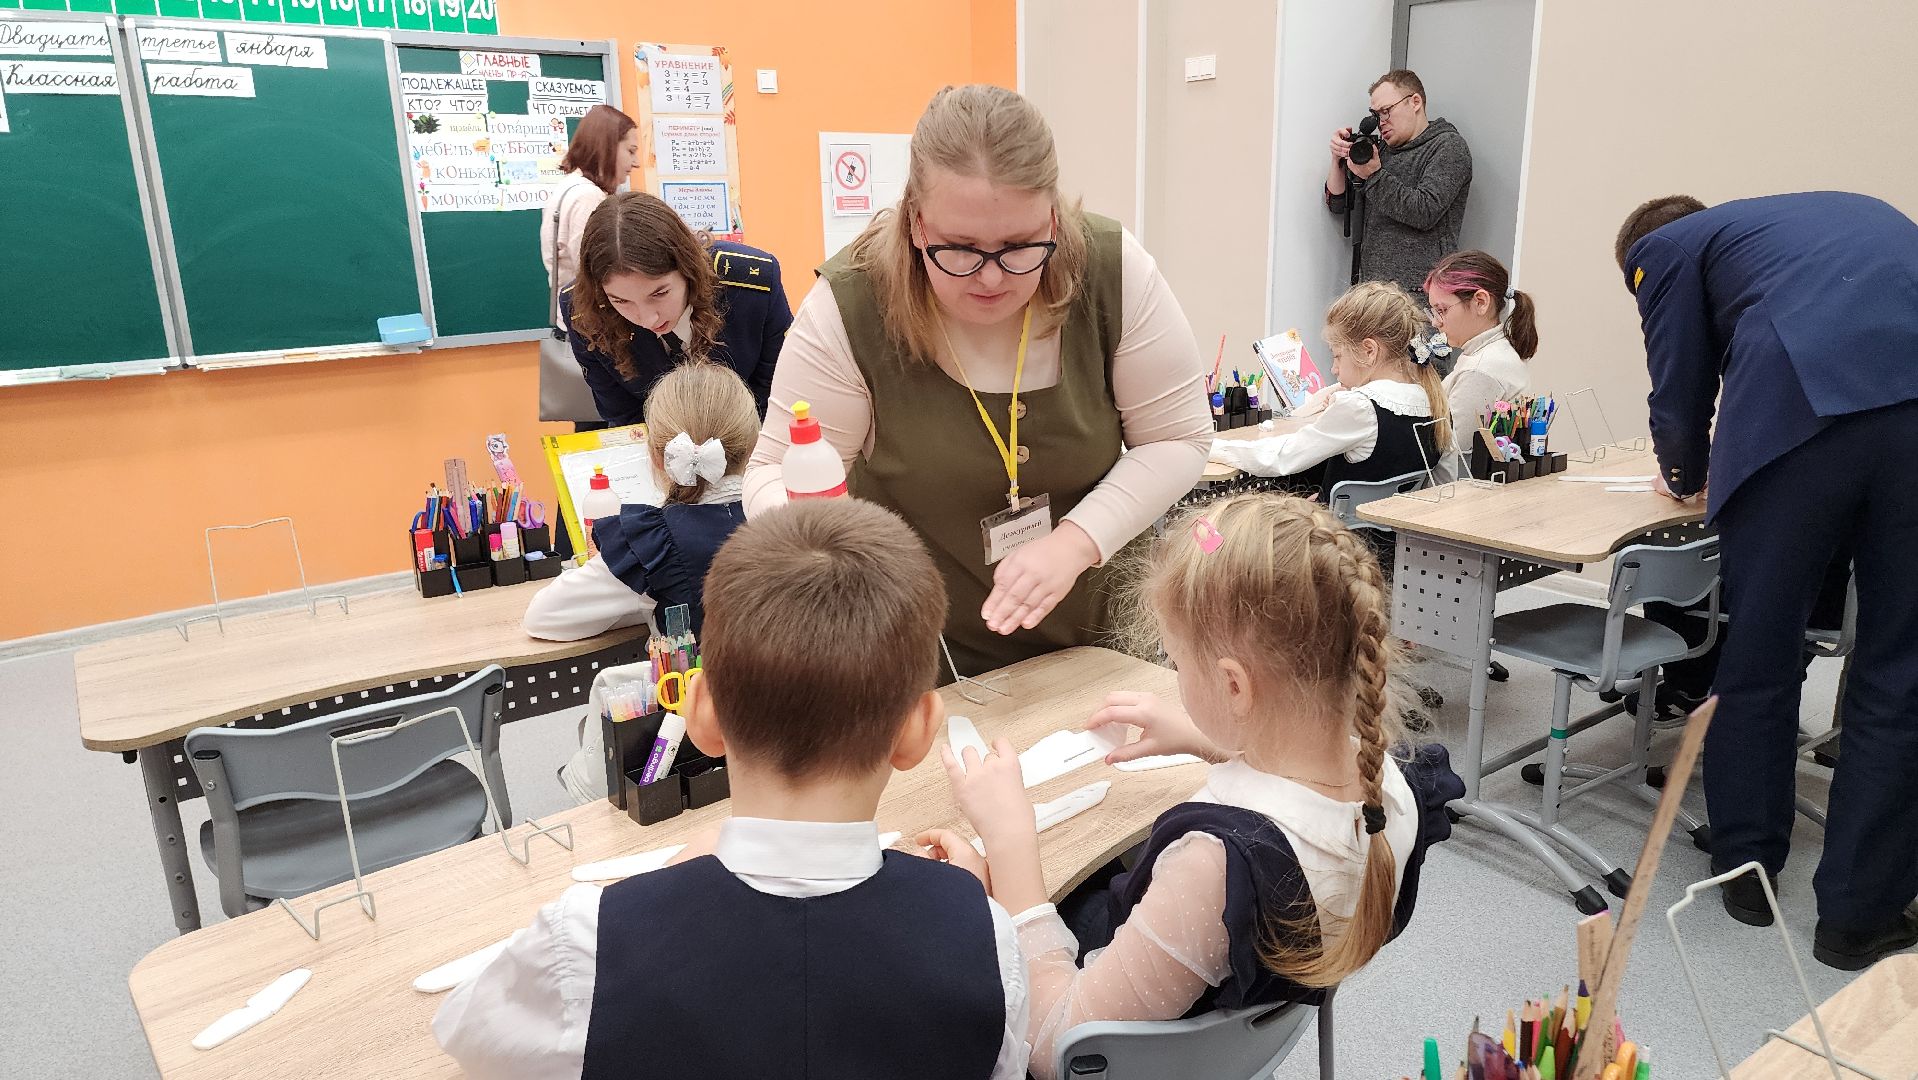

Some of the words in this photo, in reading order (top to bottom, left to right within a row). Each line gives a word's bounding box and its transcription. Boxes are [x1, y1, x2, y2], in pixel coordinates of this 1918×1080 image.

[0, 24, 111, 52] Двадцать
[142, 35, 216, 55] третье
[236, 35, 314, 65] января
[475, 54, 531, 68] ГЛАВНЫЕ
[654, 60, 714, 71] УРАВНЕНИЕ
[6, 64, 116, 87] Классная
[152, 67, 238, 94] работа
[402, 77, 485, 91] ПОДЛЕЖАЩЕЕ
[535, 81, 597, 95] СКАЗУЕМОЕ
[408, 99, 441, 110] КТО?
[450, 100, 482, 111] ЧТО?
[532, 103, 556, 115] ЧТО
[559, 105, 589, 116] ДЕЛАЕТ
[643, 753, 659, 783] berlingo
